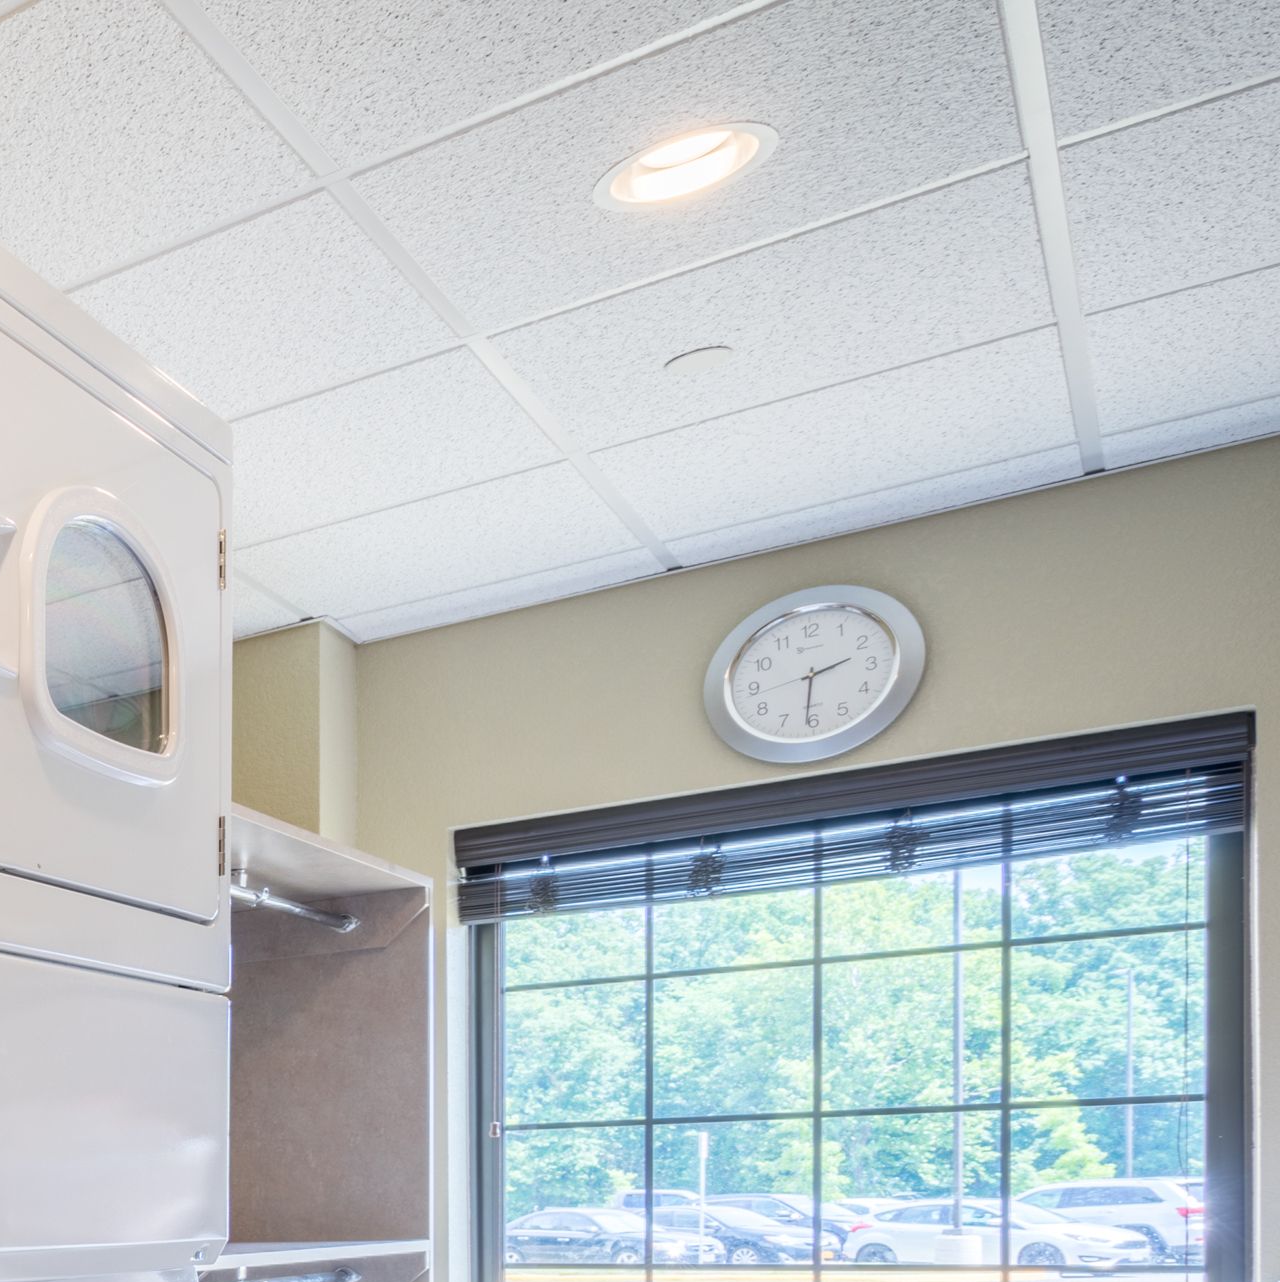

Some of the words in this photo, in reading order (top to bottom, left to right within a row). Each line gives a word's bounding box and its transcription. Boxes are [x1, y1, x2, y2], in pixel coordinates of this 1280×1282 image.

[801, 623, 819, 638] 12
[837, 624, 844, 636] 1
[776, 636, 790, 650] 11
[856, 635, 868, 650] 2
[755, 657, 772, 672] 10
[865, 656, 878, 670] 3
[748, 681, 760, 695] 9
[858, 681, 870, 694] 4
[757, 702, 768, 716] 8
[837, 702, 848, 716] 5
[779, 714, 790, 728] 7
[808, 714, 819, 728] 6
